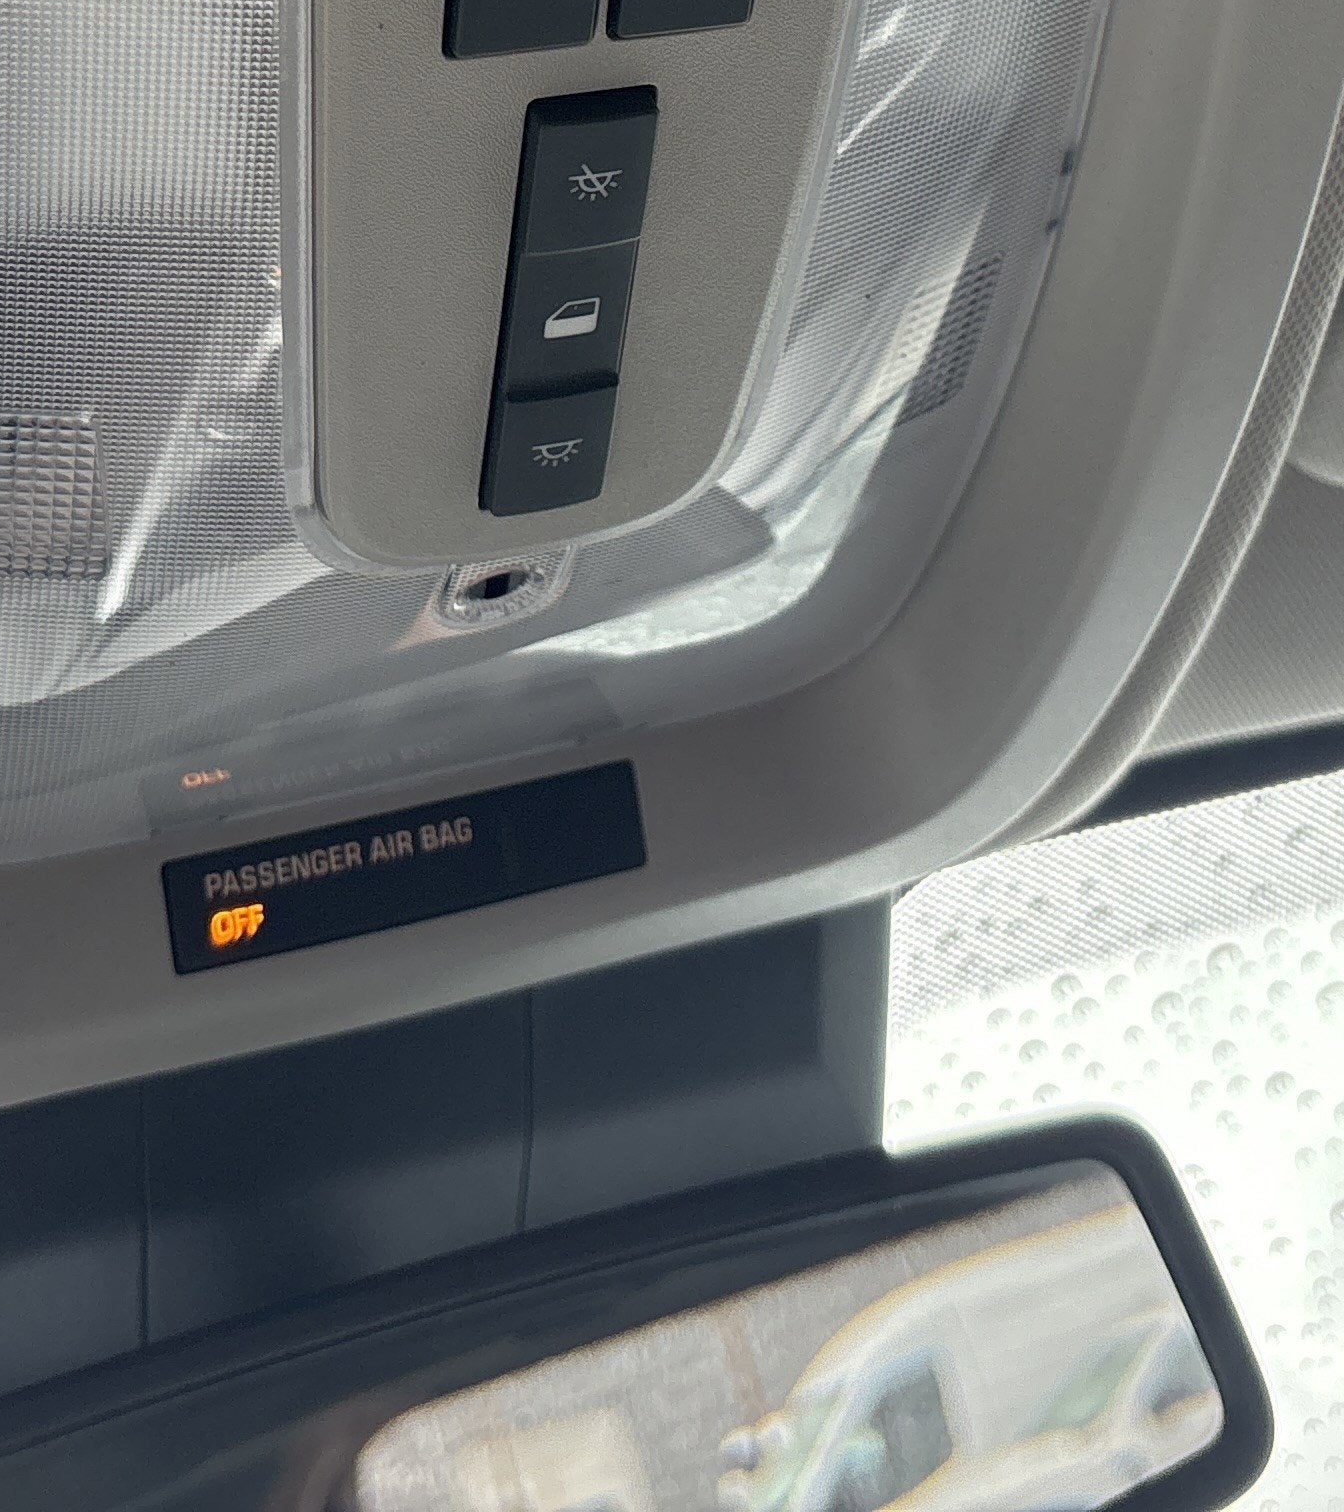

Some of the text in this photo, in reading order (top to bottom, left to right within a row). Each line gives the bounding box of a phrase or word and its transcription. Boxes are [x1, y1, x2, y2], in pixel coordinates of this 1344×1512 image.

[205, 816, 473, 899] PASSENGER AIR BAG
[210, 903, 264, 948] OFF
